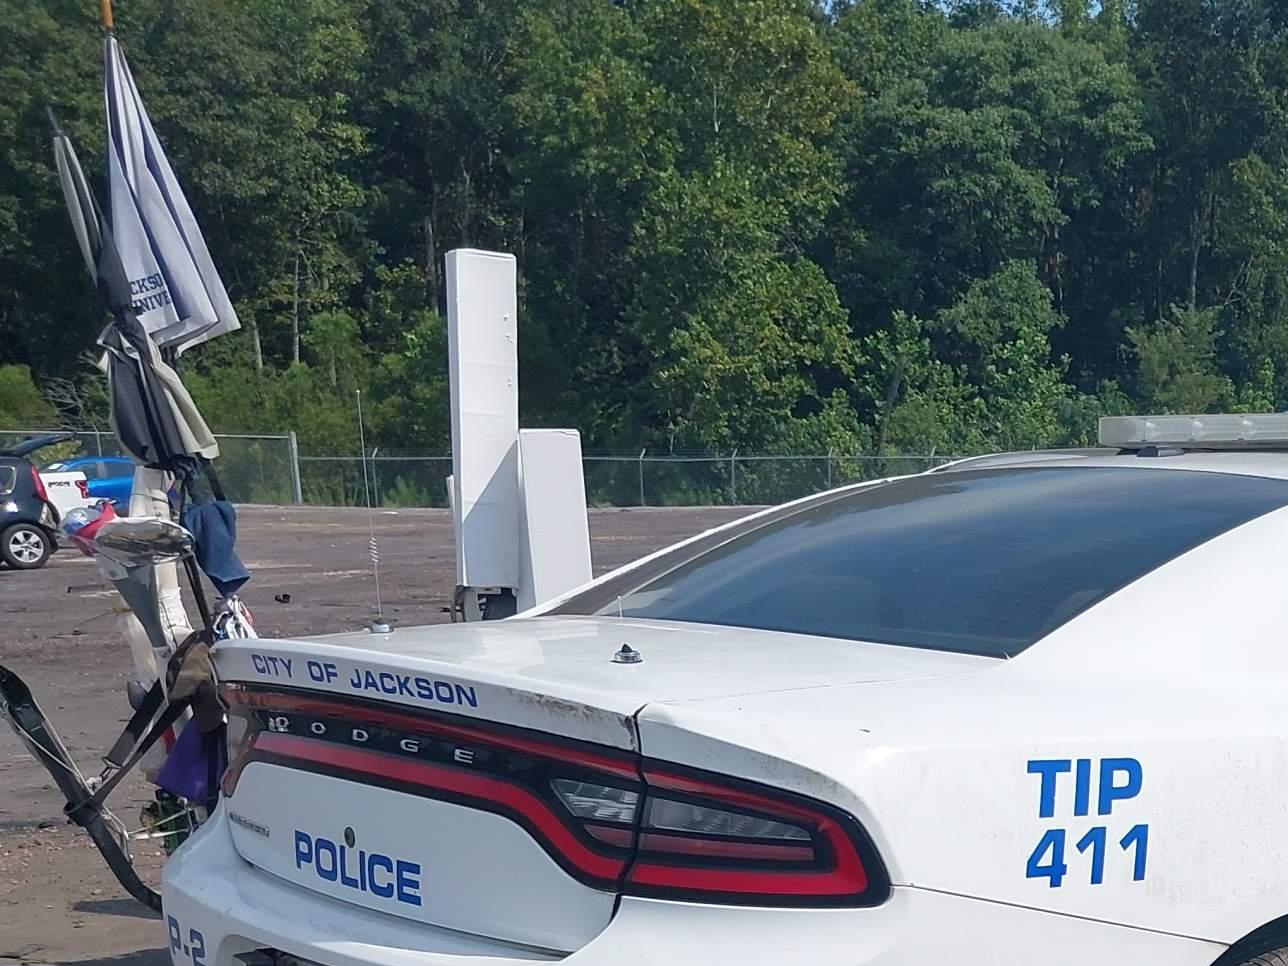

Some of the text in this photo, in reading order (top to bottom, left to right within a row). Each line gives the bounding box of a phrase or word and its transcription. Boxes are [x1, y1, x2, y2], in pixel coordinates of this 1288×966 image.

[251, 654, 478, 708] CITY OF JACKSON
[1027, 757, 1143, 818] TIP
[294, 829, 422, 906] POLICE
[1026, 824, 1148, 888] 411
